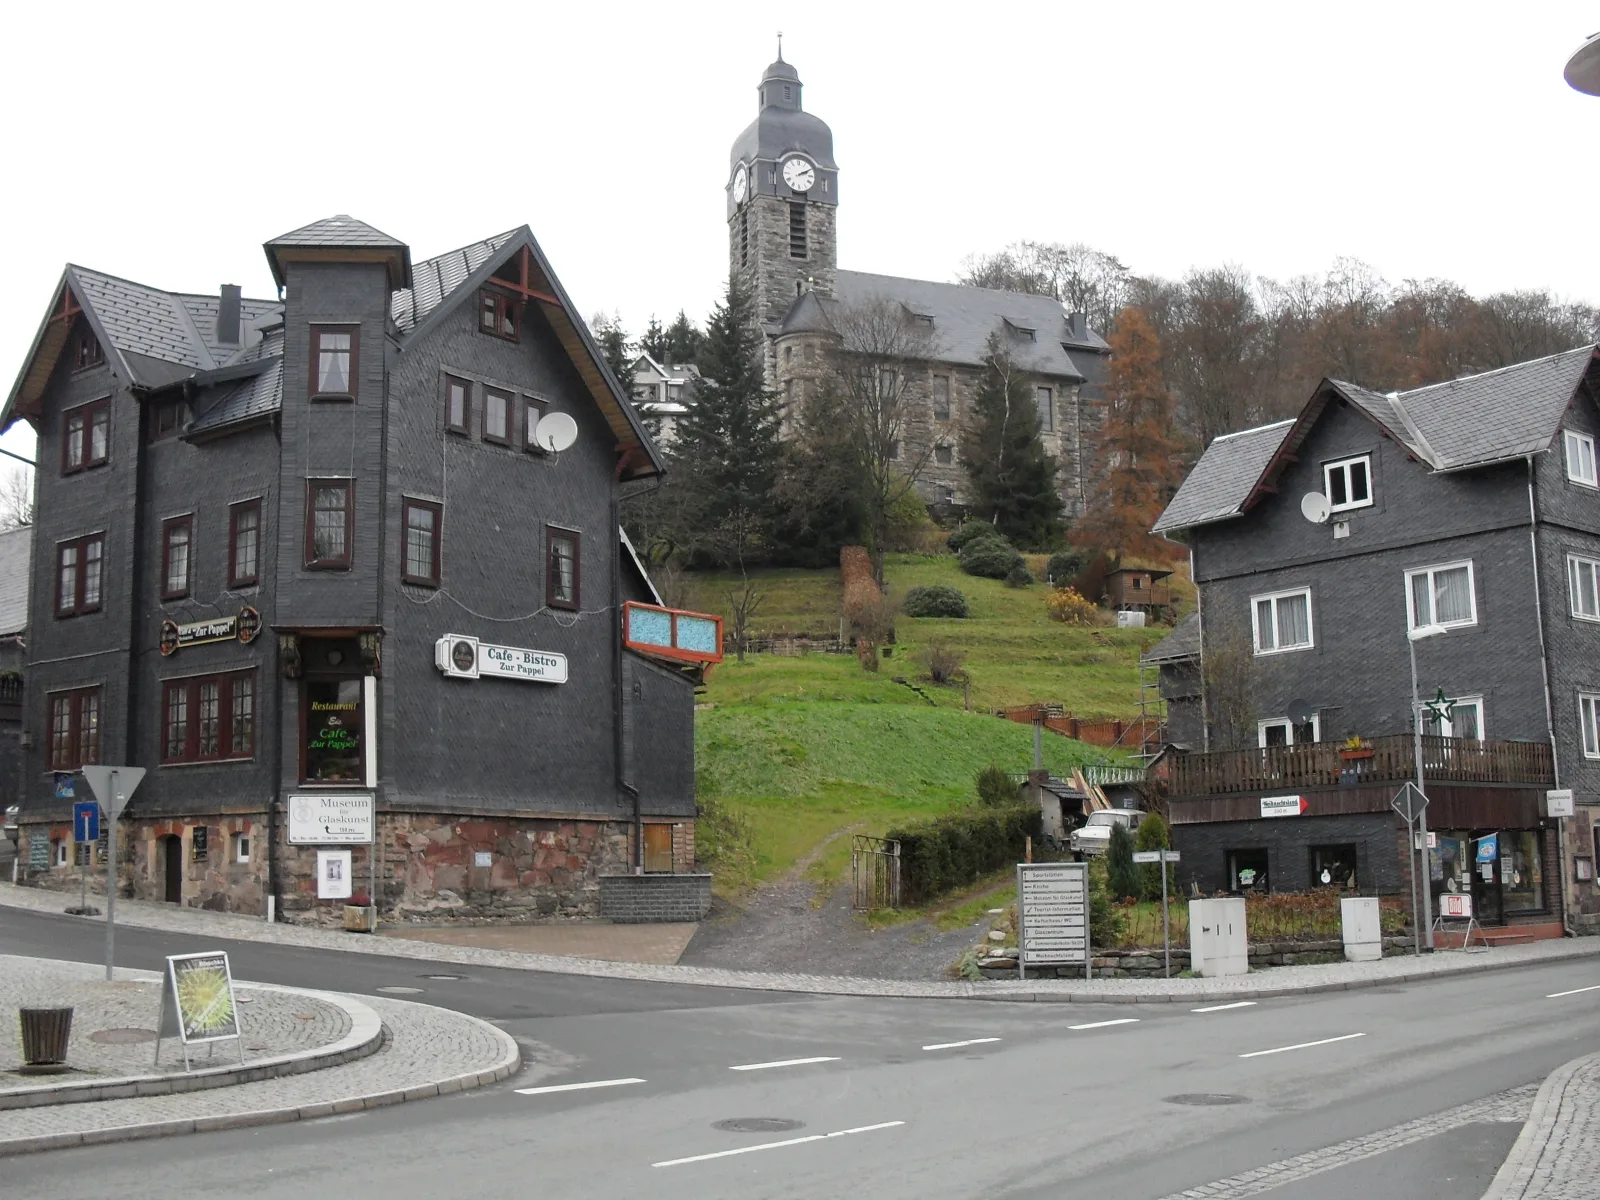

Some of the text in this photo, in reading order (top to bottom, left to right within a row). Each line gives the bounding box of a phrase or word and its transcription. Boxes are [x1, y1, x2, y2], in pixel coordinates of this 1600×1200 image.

[487, 647, 513, 661] Cafe
[523, 652, 557, 667] Bistro
[499, 661, 545, 676] Zur Pappel
[311, 701, 357, 711] Restaurant
[319, 728, 347, 738] Cafe
[320, 798, 368, 808] Museum
[318, 815, 369, 824] Glaskunst
